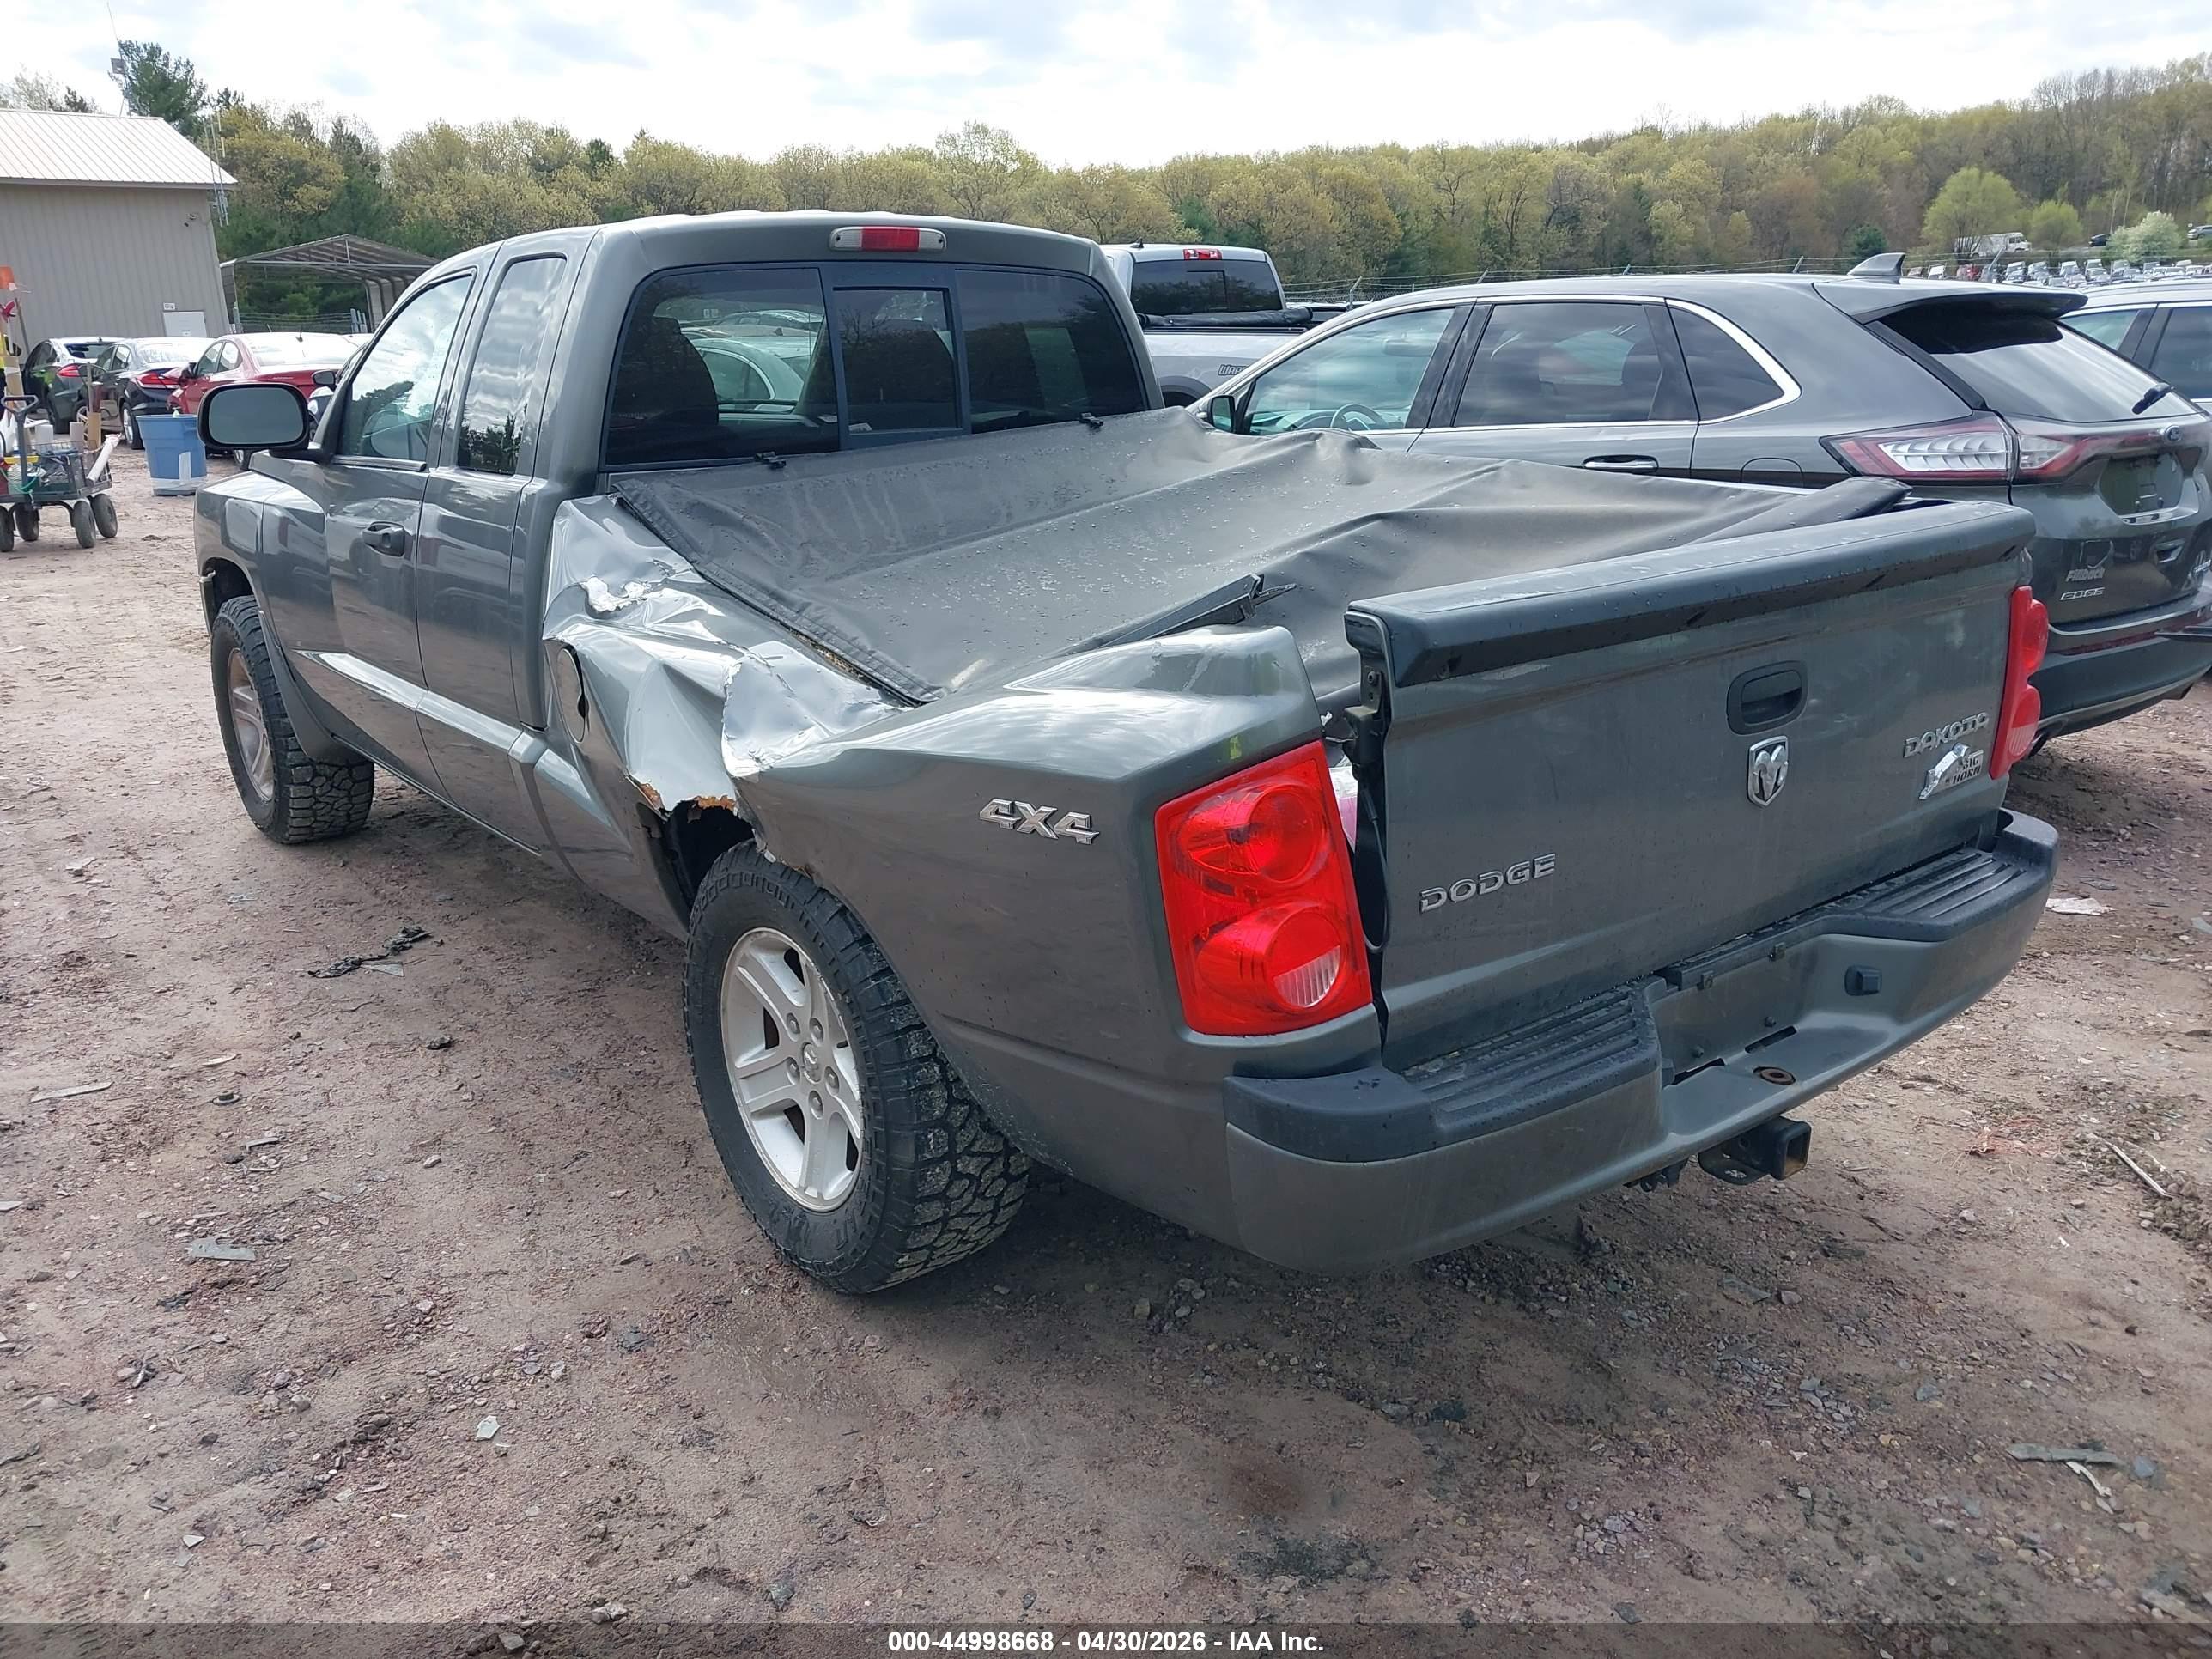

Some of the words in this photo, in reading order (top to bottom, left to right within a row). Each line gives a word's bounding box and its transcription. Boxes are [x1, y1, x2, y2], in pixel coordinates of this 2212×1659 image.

[2060, 586, 2106, 601] EDGE
[1902, 711, 1990, 758] DAKOTA
[1953, 765, 1981, 785] HORN
[1962, 756, 1979, 770] BIG
[979, 798, 1100, 845] 4X4
[1419, 853, 1556, 915] DODGE
